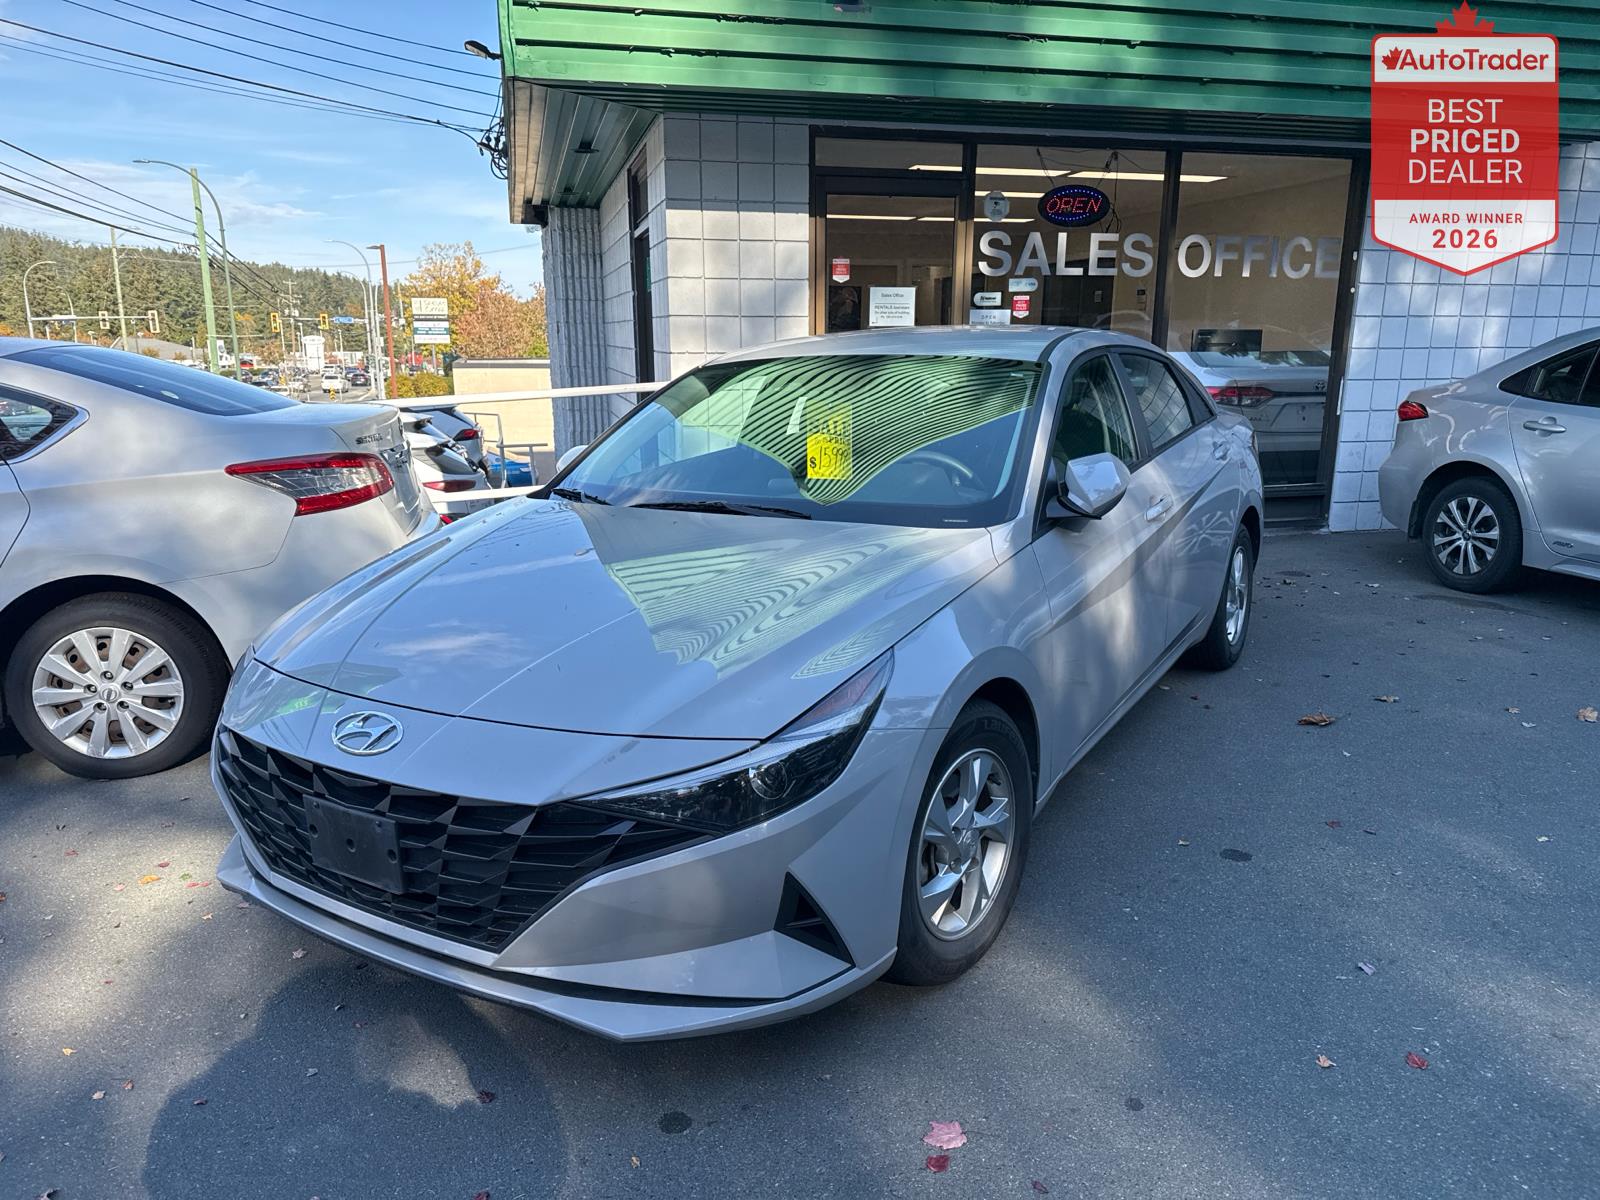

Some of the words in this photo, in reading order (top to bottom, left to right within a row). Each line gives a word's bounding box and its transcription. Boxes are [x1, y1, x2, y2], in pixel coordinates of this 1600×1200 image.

[1046, 197, 1103, 214] OPEN
[978, 230, 1154, 278] SALES
[1177, 234, 1343, 280] OFFICE
